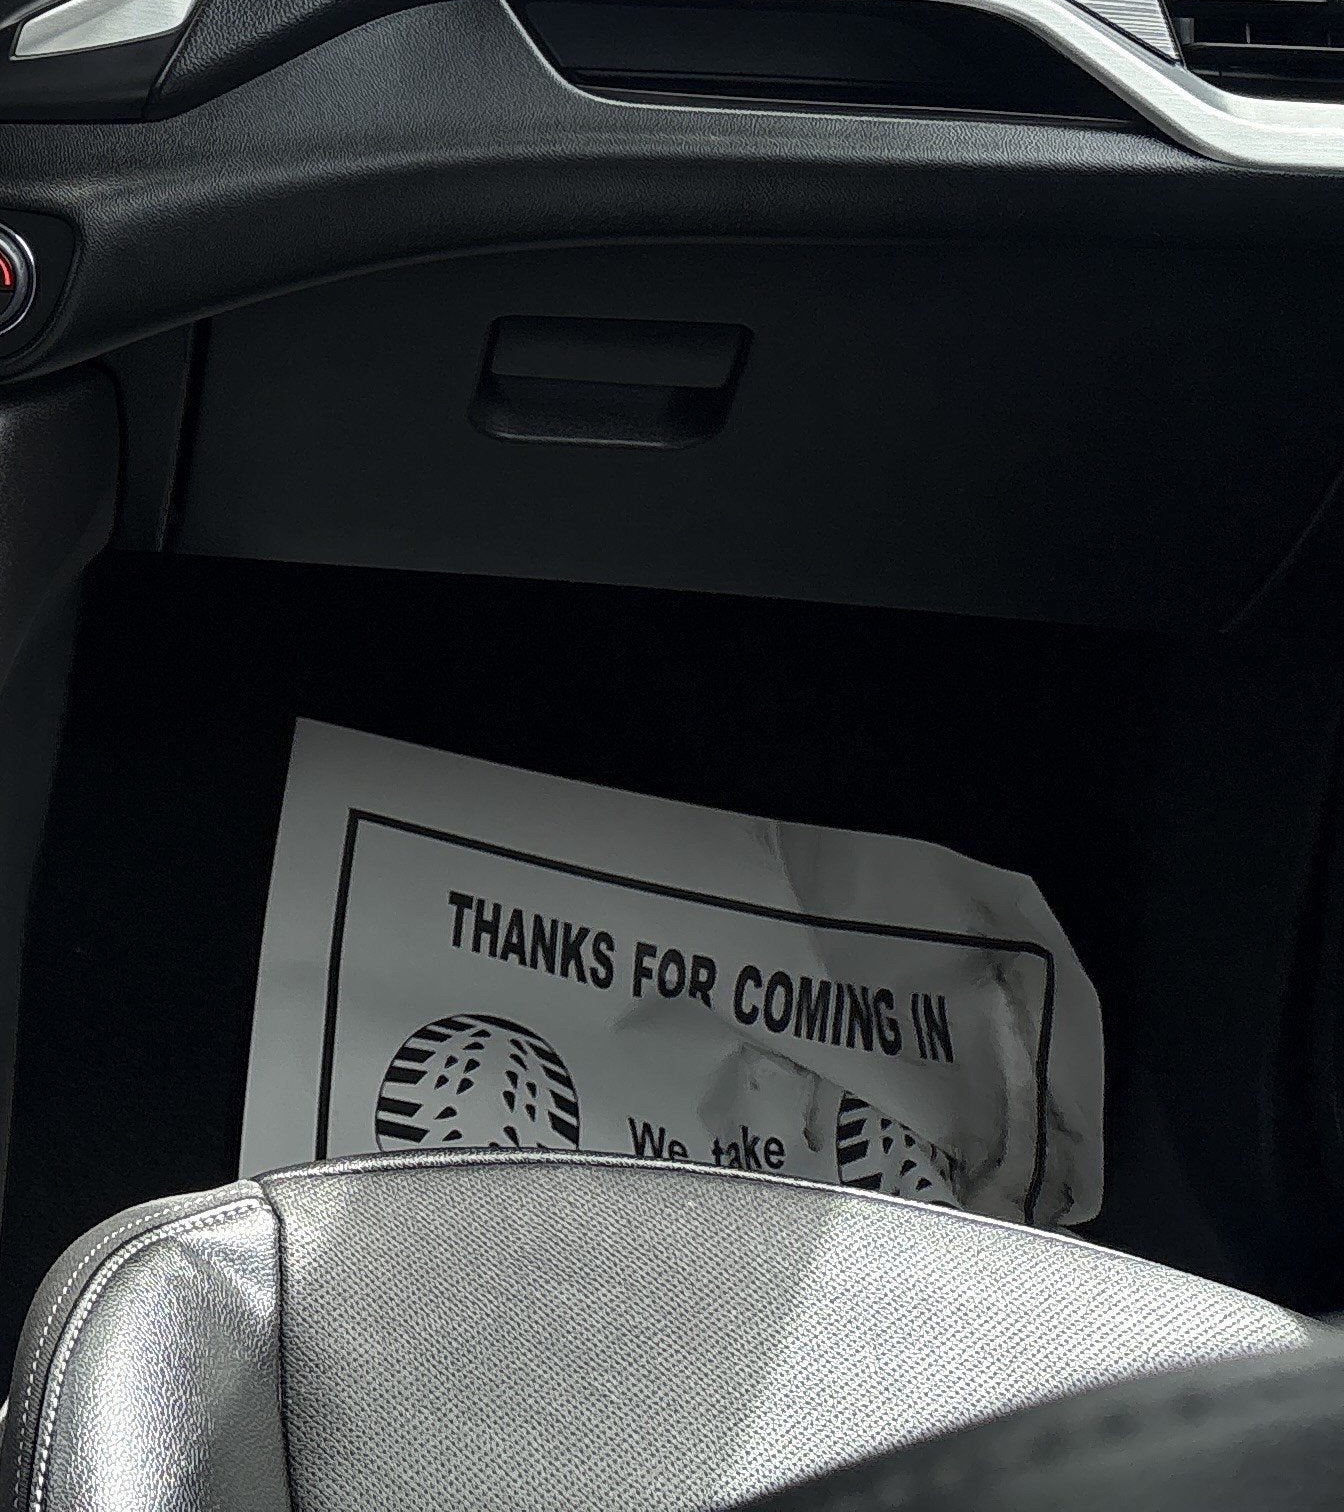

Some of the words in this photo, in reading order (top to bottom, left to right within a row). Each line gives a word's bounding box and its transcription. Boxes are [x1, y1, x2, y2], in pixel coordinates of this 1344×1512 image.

[448, 890, 614, 990] THANKS
[632, 941, 717, 1008] FOR
[733, 964, 904, 1057] COMING
[911, 991, 955, 1064] IN
[627, 1116, 689, 1160] We
[712, 1125, 786, 1171] take
